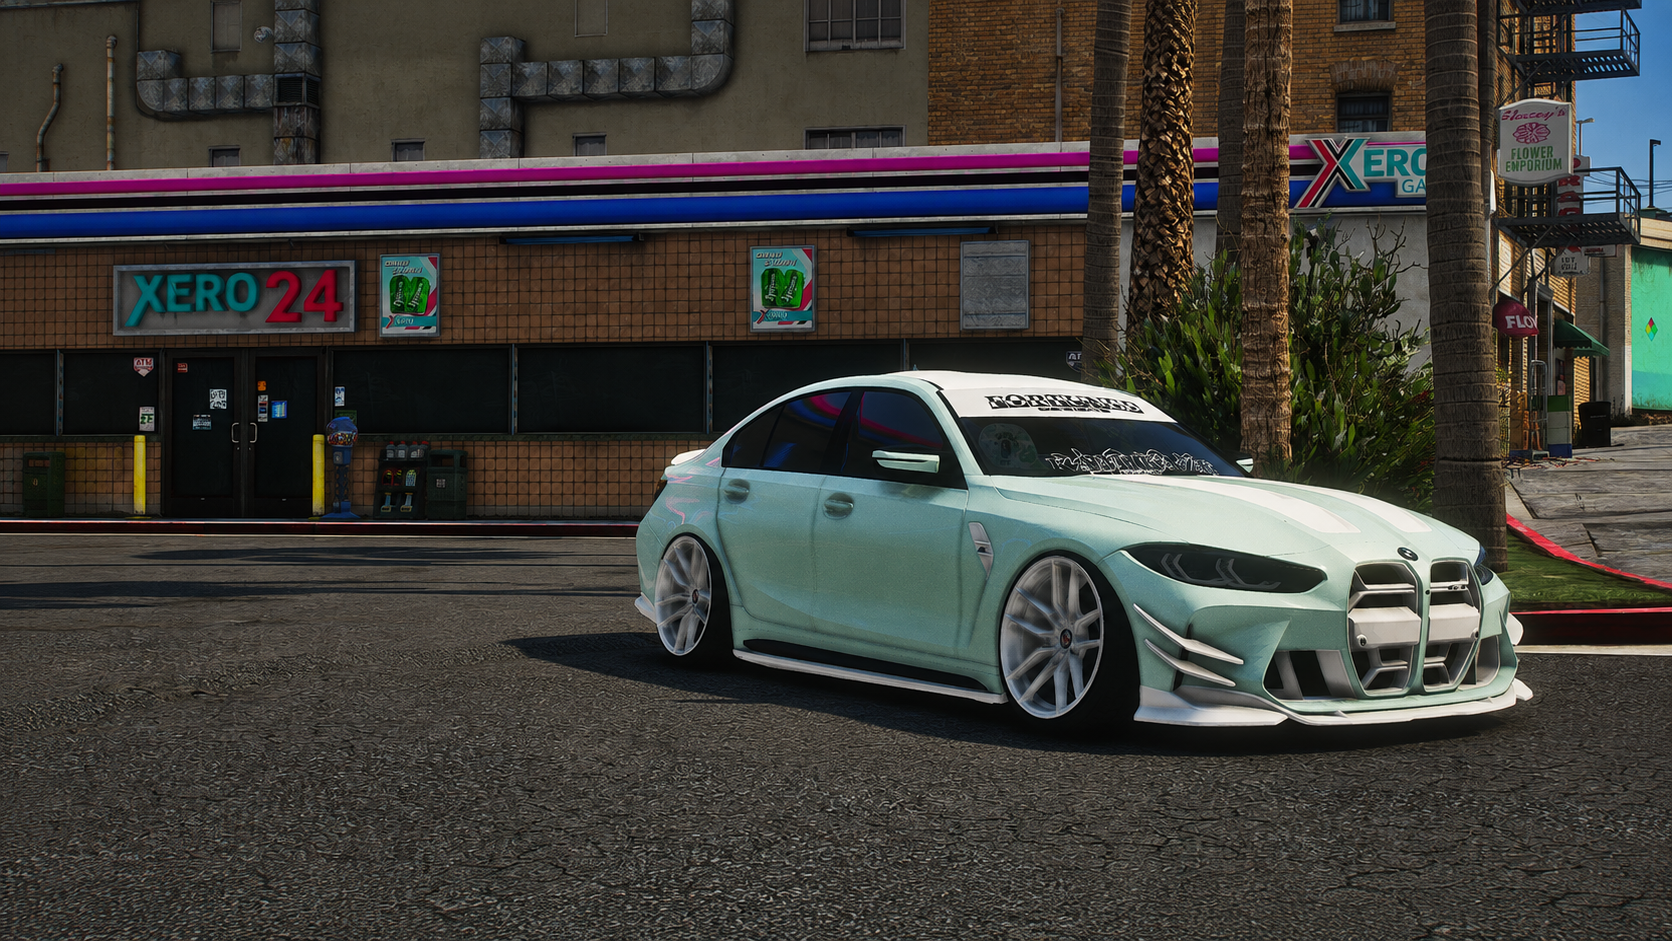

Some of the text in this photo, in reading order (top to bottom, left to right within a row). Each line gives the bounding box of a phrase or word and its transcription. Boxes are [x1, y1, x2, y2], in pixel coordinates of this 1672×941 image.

[1511, 146, 1553, 159] FLOWER
[1506, 158, 1562, 172] EMPORIUM
[1402, 178, 1427, 193] GA
[124, 272, 260, 327] XERO
[265, 269, 344, 323] 24
